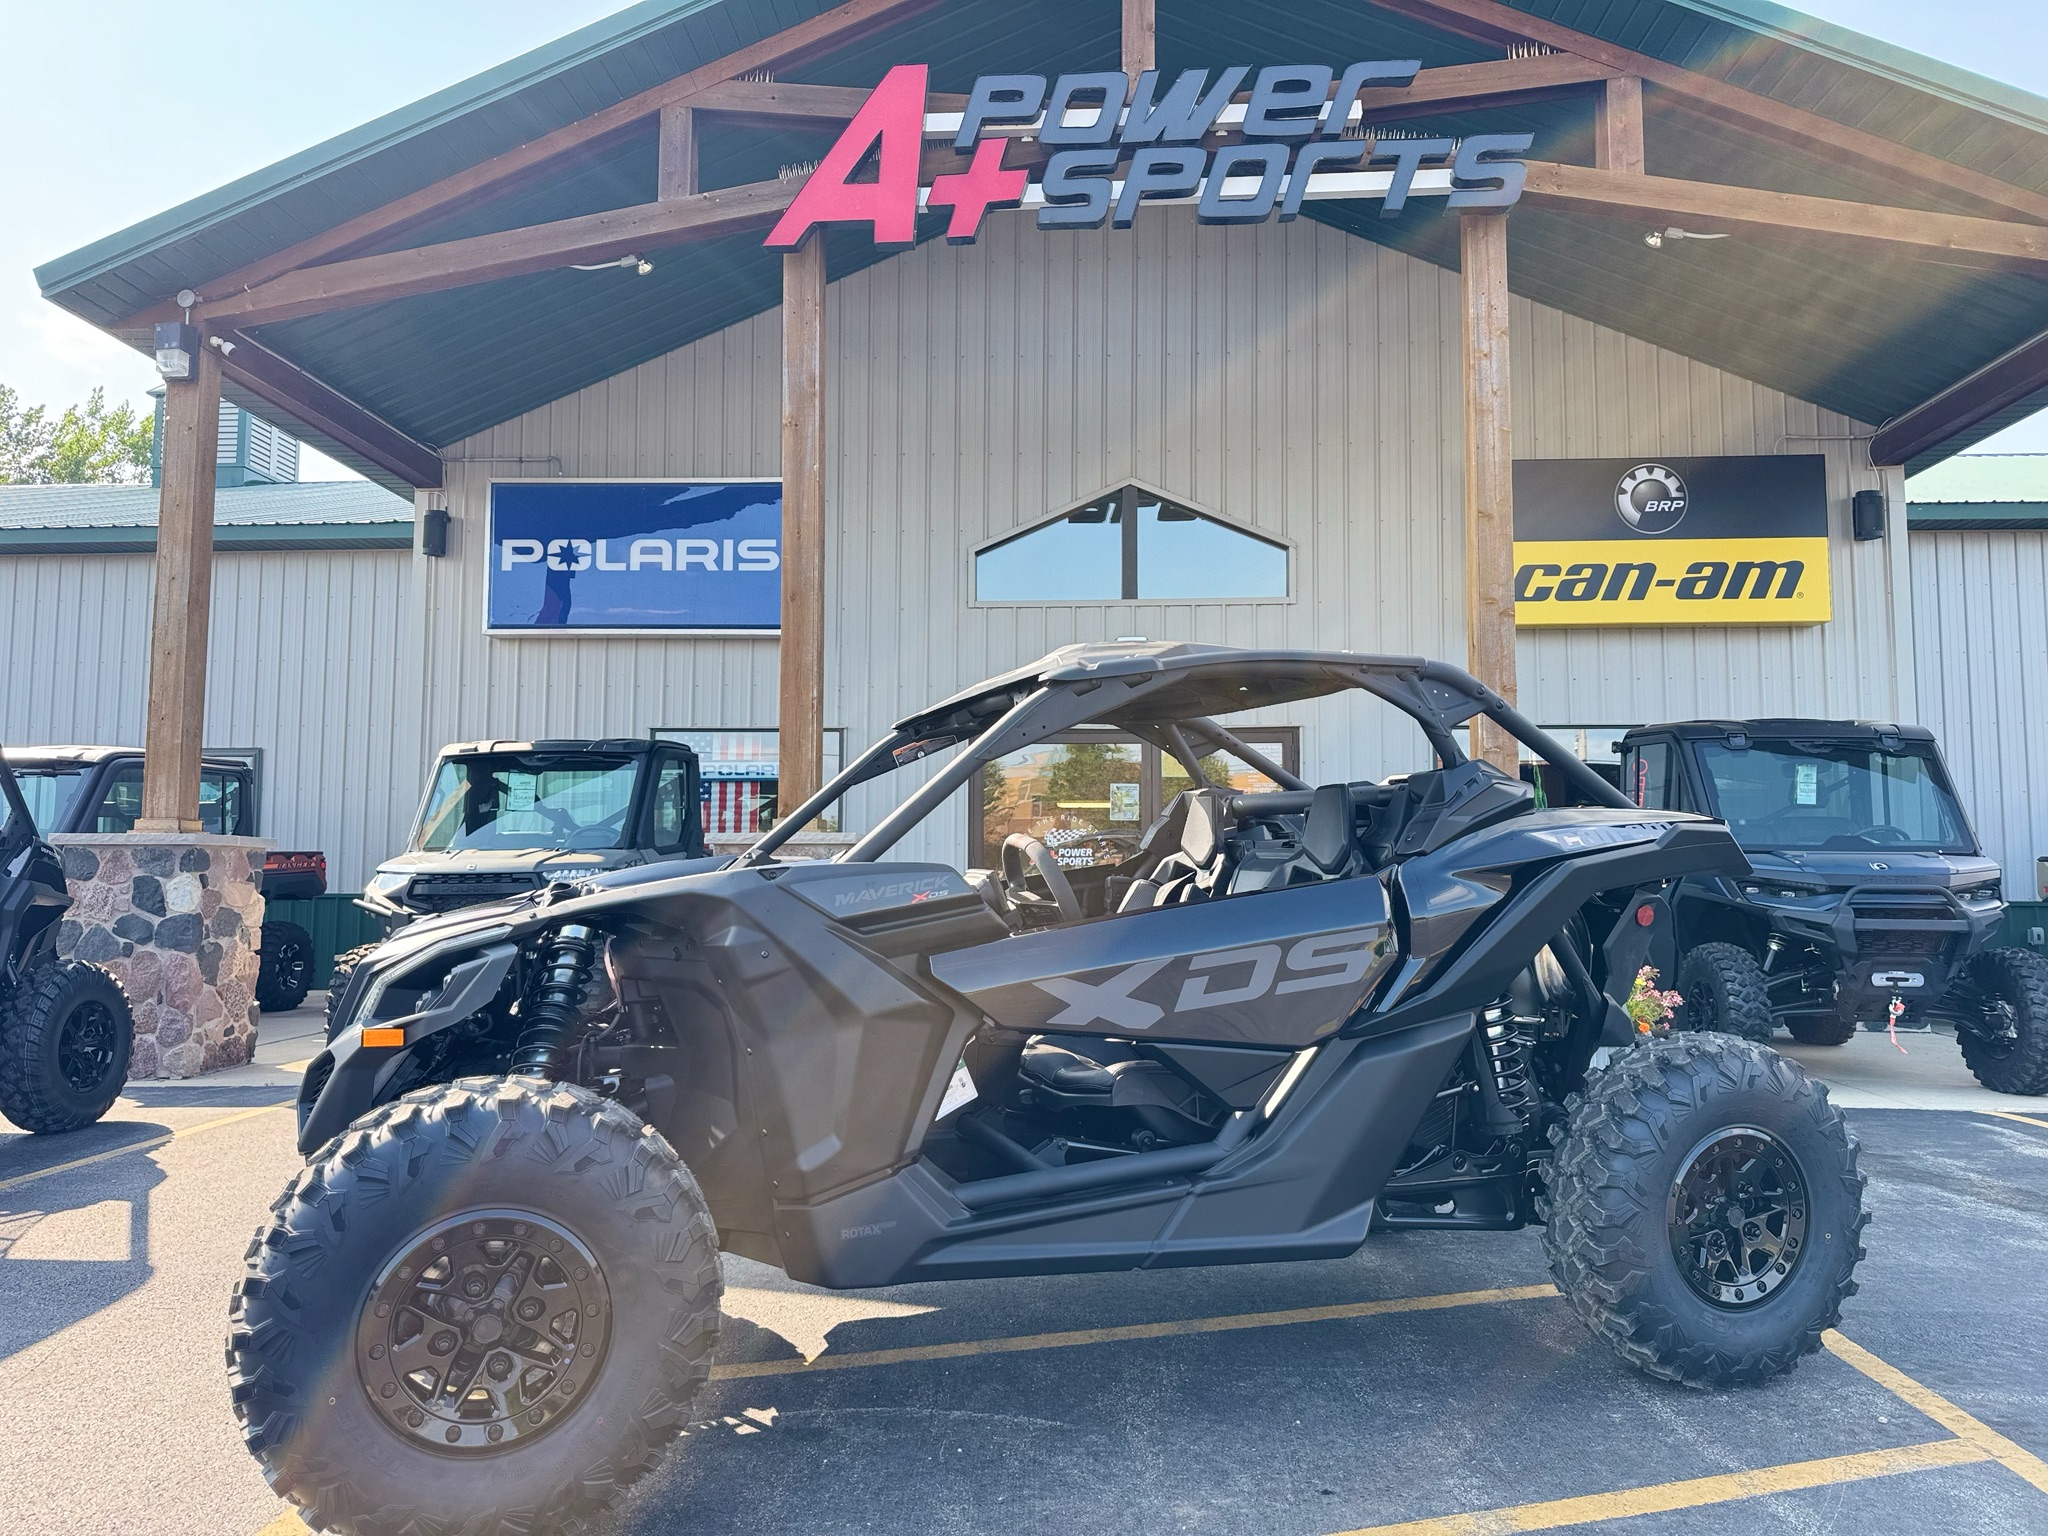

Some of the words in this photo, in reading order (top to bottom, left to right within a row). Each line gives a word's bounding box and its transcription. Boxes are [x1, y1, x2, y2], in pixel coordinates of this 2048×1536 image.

[1644, 500, 1685, 512] BRP
[501, 538, 780, 572] POLARIS
[702, 764, 780, 776] POLAR
[1060, 814, 1085, 826] RIDE
[1058, 848, 1093, 857] POWER
[624, 858, 644, 869] XP
[1057, 857, 1094, 866] SPORTS
[441, 884, 498, 893] POLARIS
[834, 875, 952, 907] MAVERICK
[1031, 928, 1379, 1030] XDS
[841, 1224, 882, 1240] ROTAX
